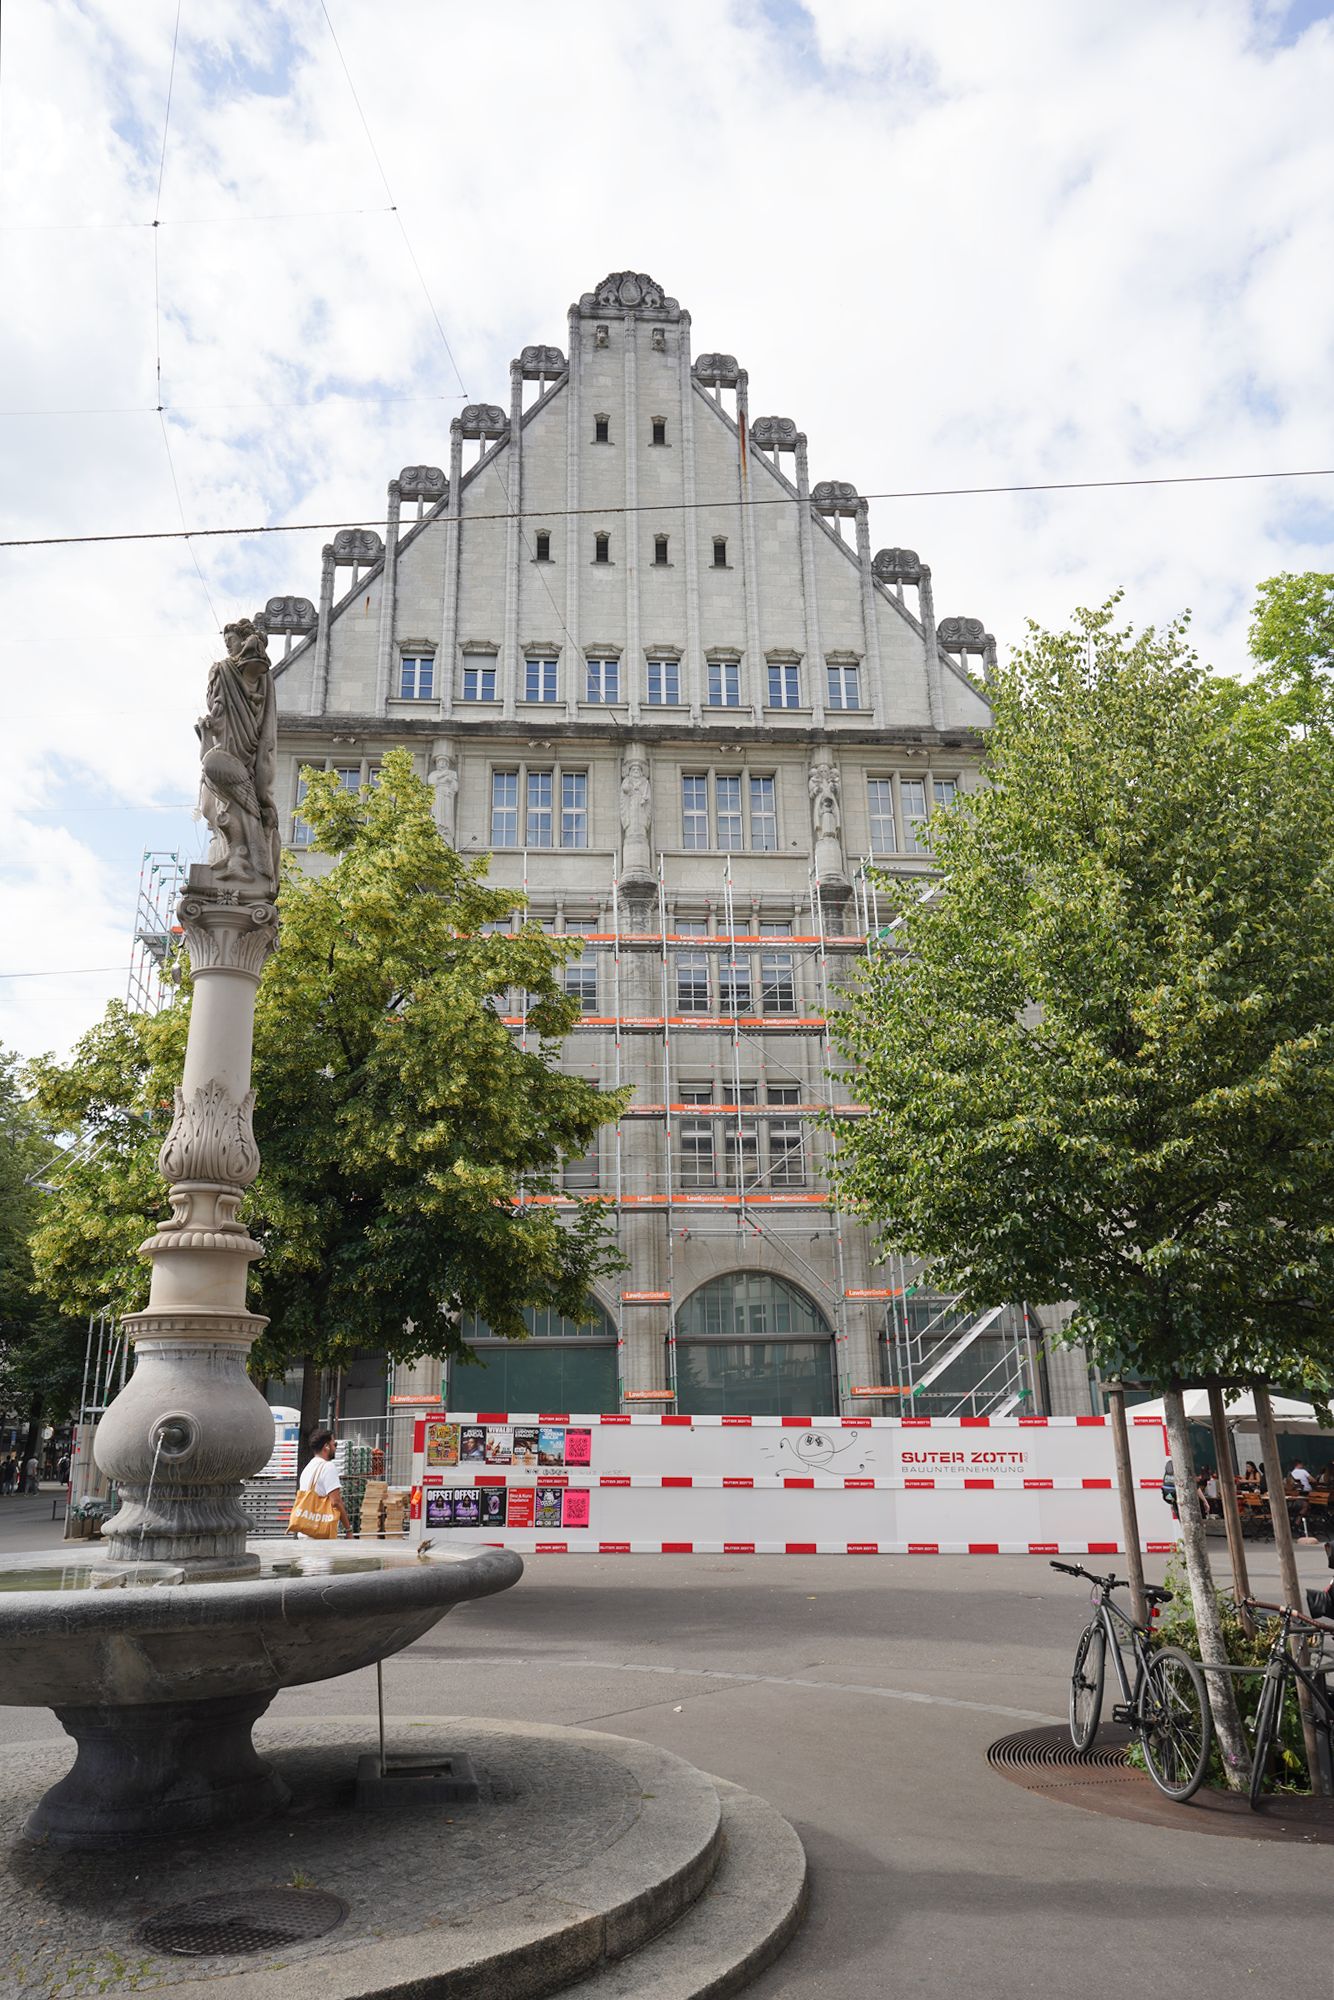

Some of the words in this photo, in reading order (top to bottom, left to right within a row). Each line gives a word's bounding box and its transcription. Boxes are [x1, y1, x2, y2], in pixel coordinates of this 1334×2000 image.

[901, 1452, 964, 1463] SUTER
[971, 1452, 1023, 1463] ZOTTI
[427, 1490, 453, 1500] OFFSET
[454, 1489, 480, 1500] OFFSET
[295, 1508, 334, 1522] SANDRO
